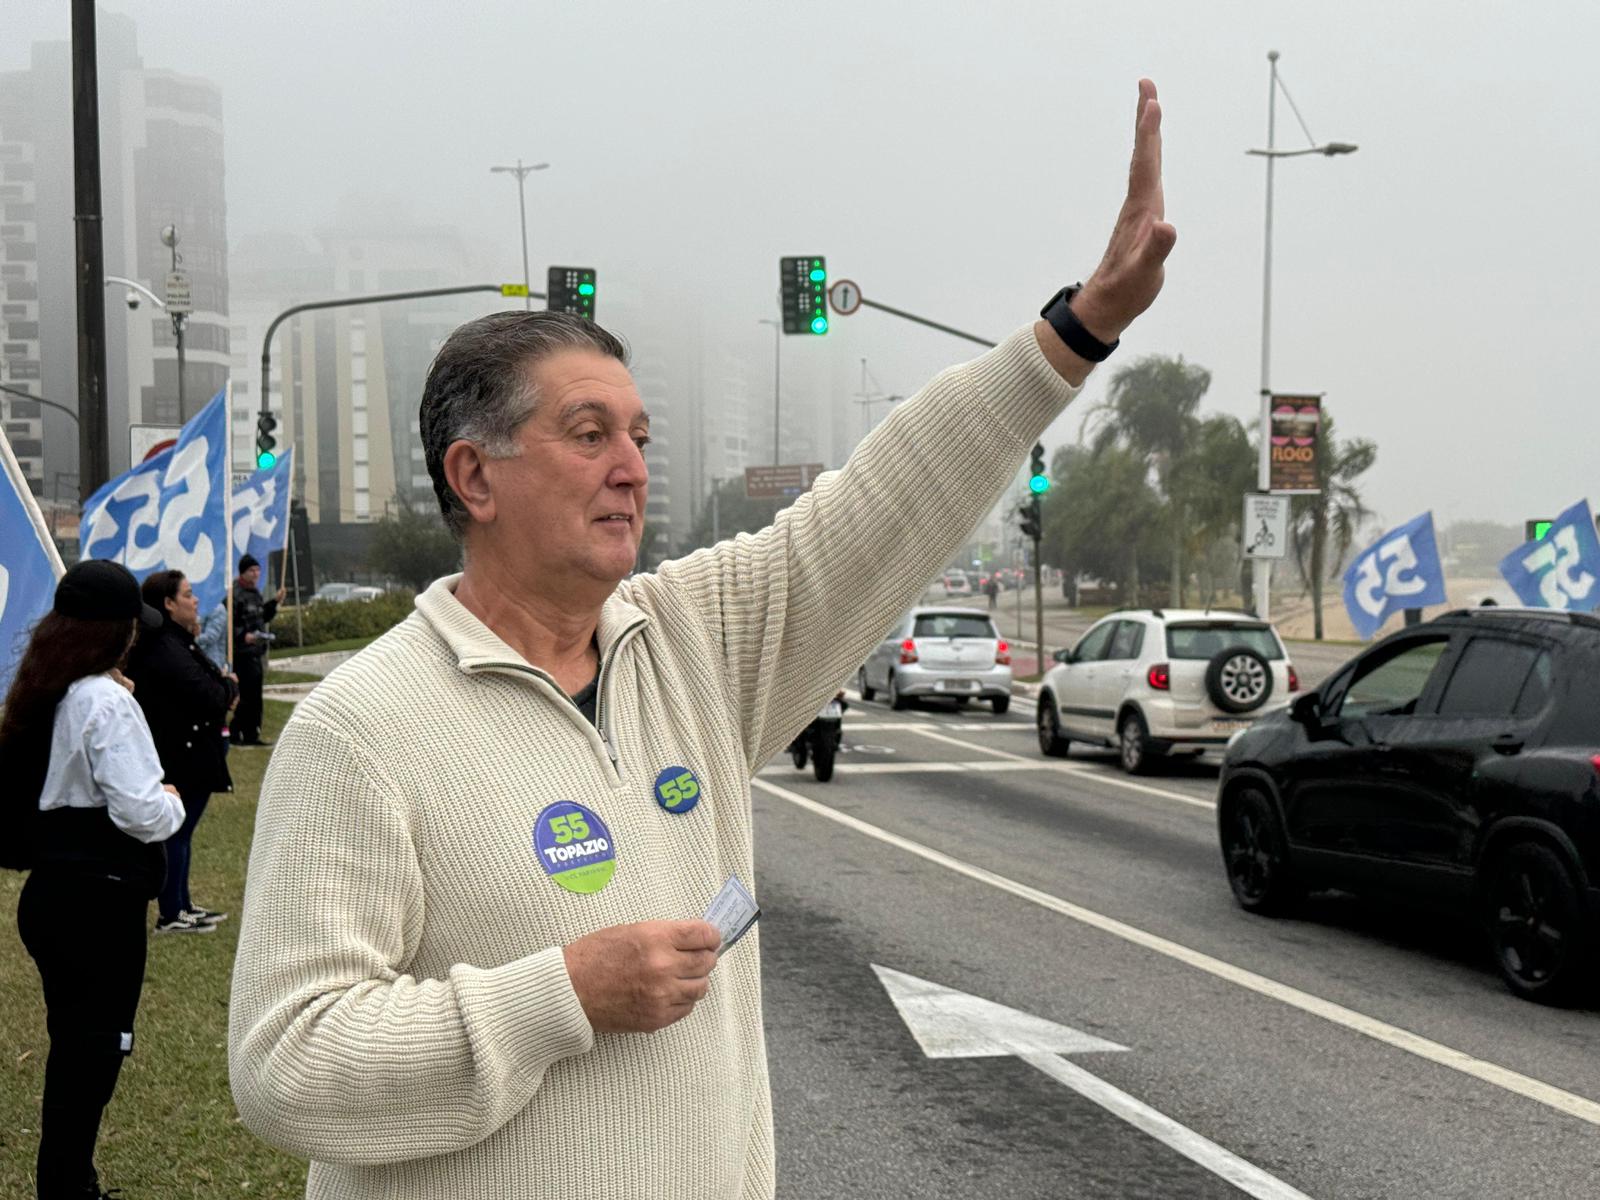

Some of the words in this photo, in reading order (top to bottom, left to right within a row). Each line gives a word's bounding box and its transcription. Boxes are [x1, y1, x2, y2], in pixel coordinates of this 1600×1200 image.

[658, 771, 699, 808] 55
[548, 811, 590, 845] 55
[543, 837, 609, 864] TOPAZIO
